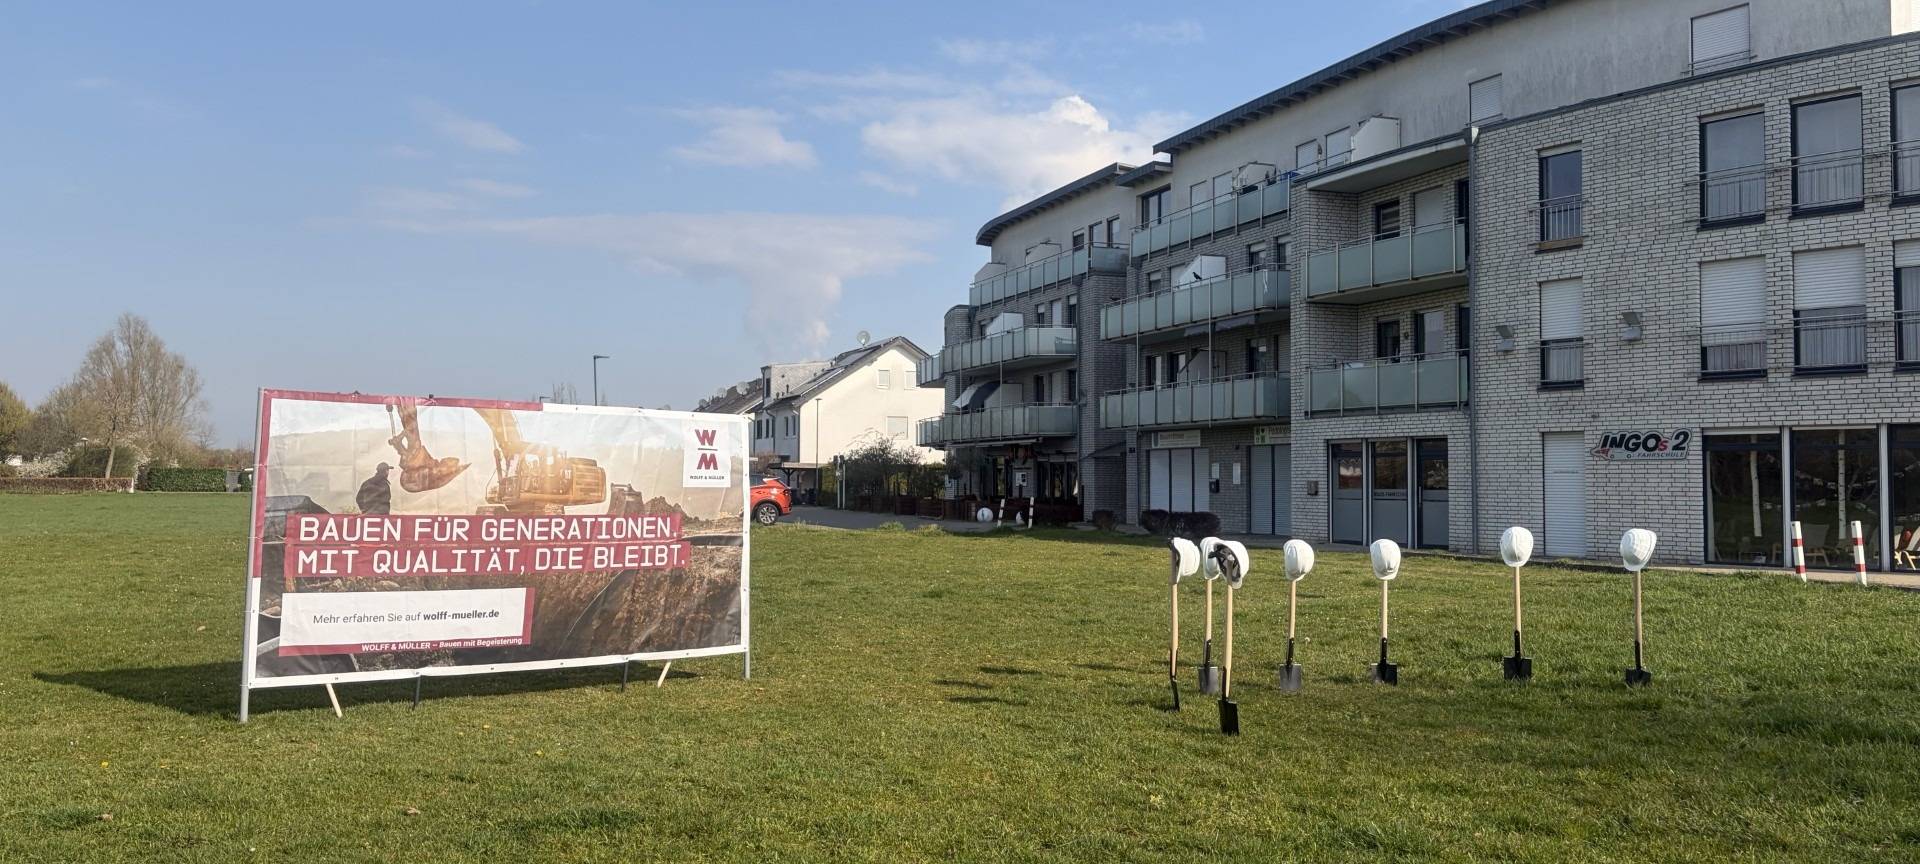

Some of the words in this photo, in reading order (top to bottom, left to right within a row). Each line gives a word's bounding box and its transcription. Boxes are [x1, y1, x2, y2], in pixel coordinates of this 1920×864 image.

[695, 429, 716, 446] W
[1672, 431, 1690, 451] 2
[697, 453, 718, 470] M
[299, 517, 402, 542] BAUEN
[414, 517, 469, 542] FÜR
[481, 517, 677, 540] GENERATIONEN.
[298, 549, 358, 575] MIT
[373, 548, 525, 575] QUALITÄT,
[535, 547, 583, 571] DIE
[593, 544, 686, 569] BLEIBT.
[312, 614, 341, 624] Mehr
[343, 612, 385, 624] erfahren
[387, 612, 403, 623] Sie
[405, 611, 421, 622] auf
[423, 609, 500, 622] wolff-mueller.de
[398, 642, 431, 650] MÜLLER
[477, 638, 522, 646] Begeisterung
